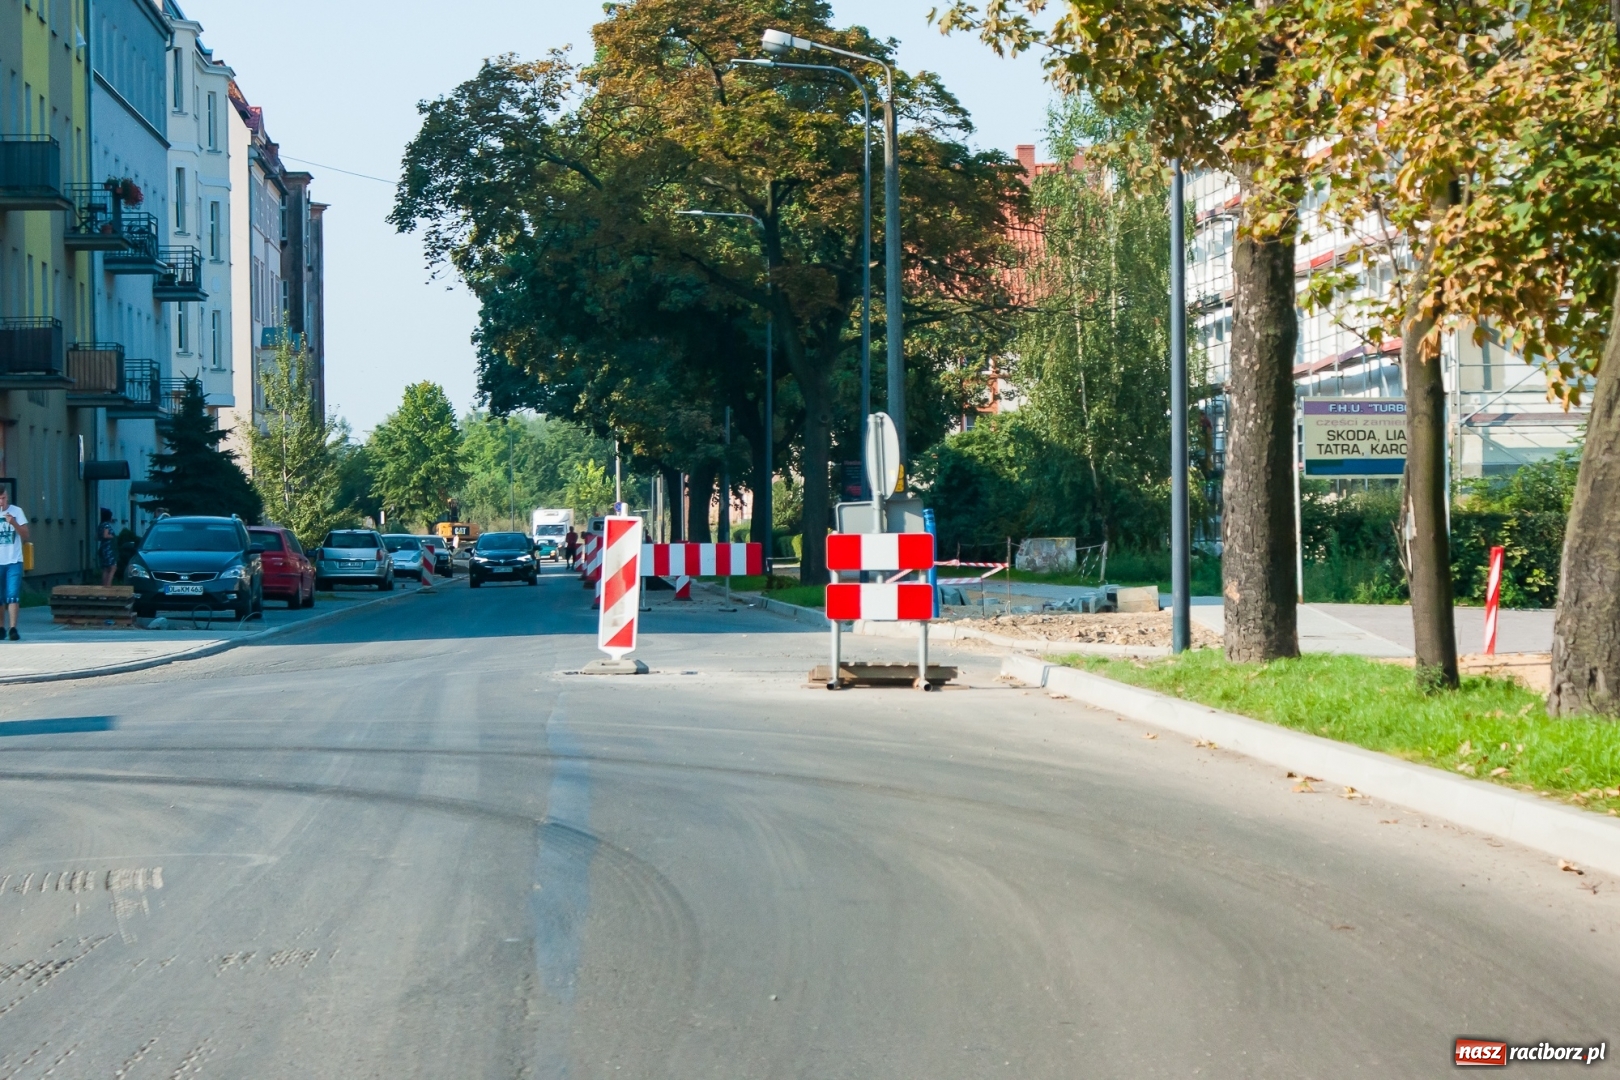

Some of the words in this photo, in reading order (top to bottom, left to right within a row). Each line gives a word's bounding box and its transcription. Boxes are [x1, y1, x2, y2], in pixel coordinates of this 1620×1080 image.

[1329, 403, 1363, 412] F.H.U.
[1368, 403, 1407, 412] "TURB
[1316, 417, 1358, 427] części
[1327, 429, 1380, 442] SKODA,
[1316, 443, 1365, 457] TATRA,
[454, 527, 467, 535] CAT
